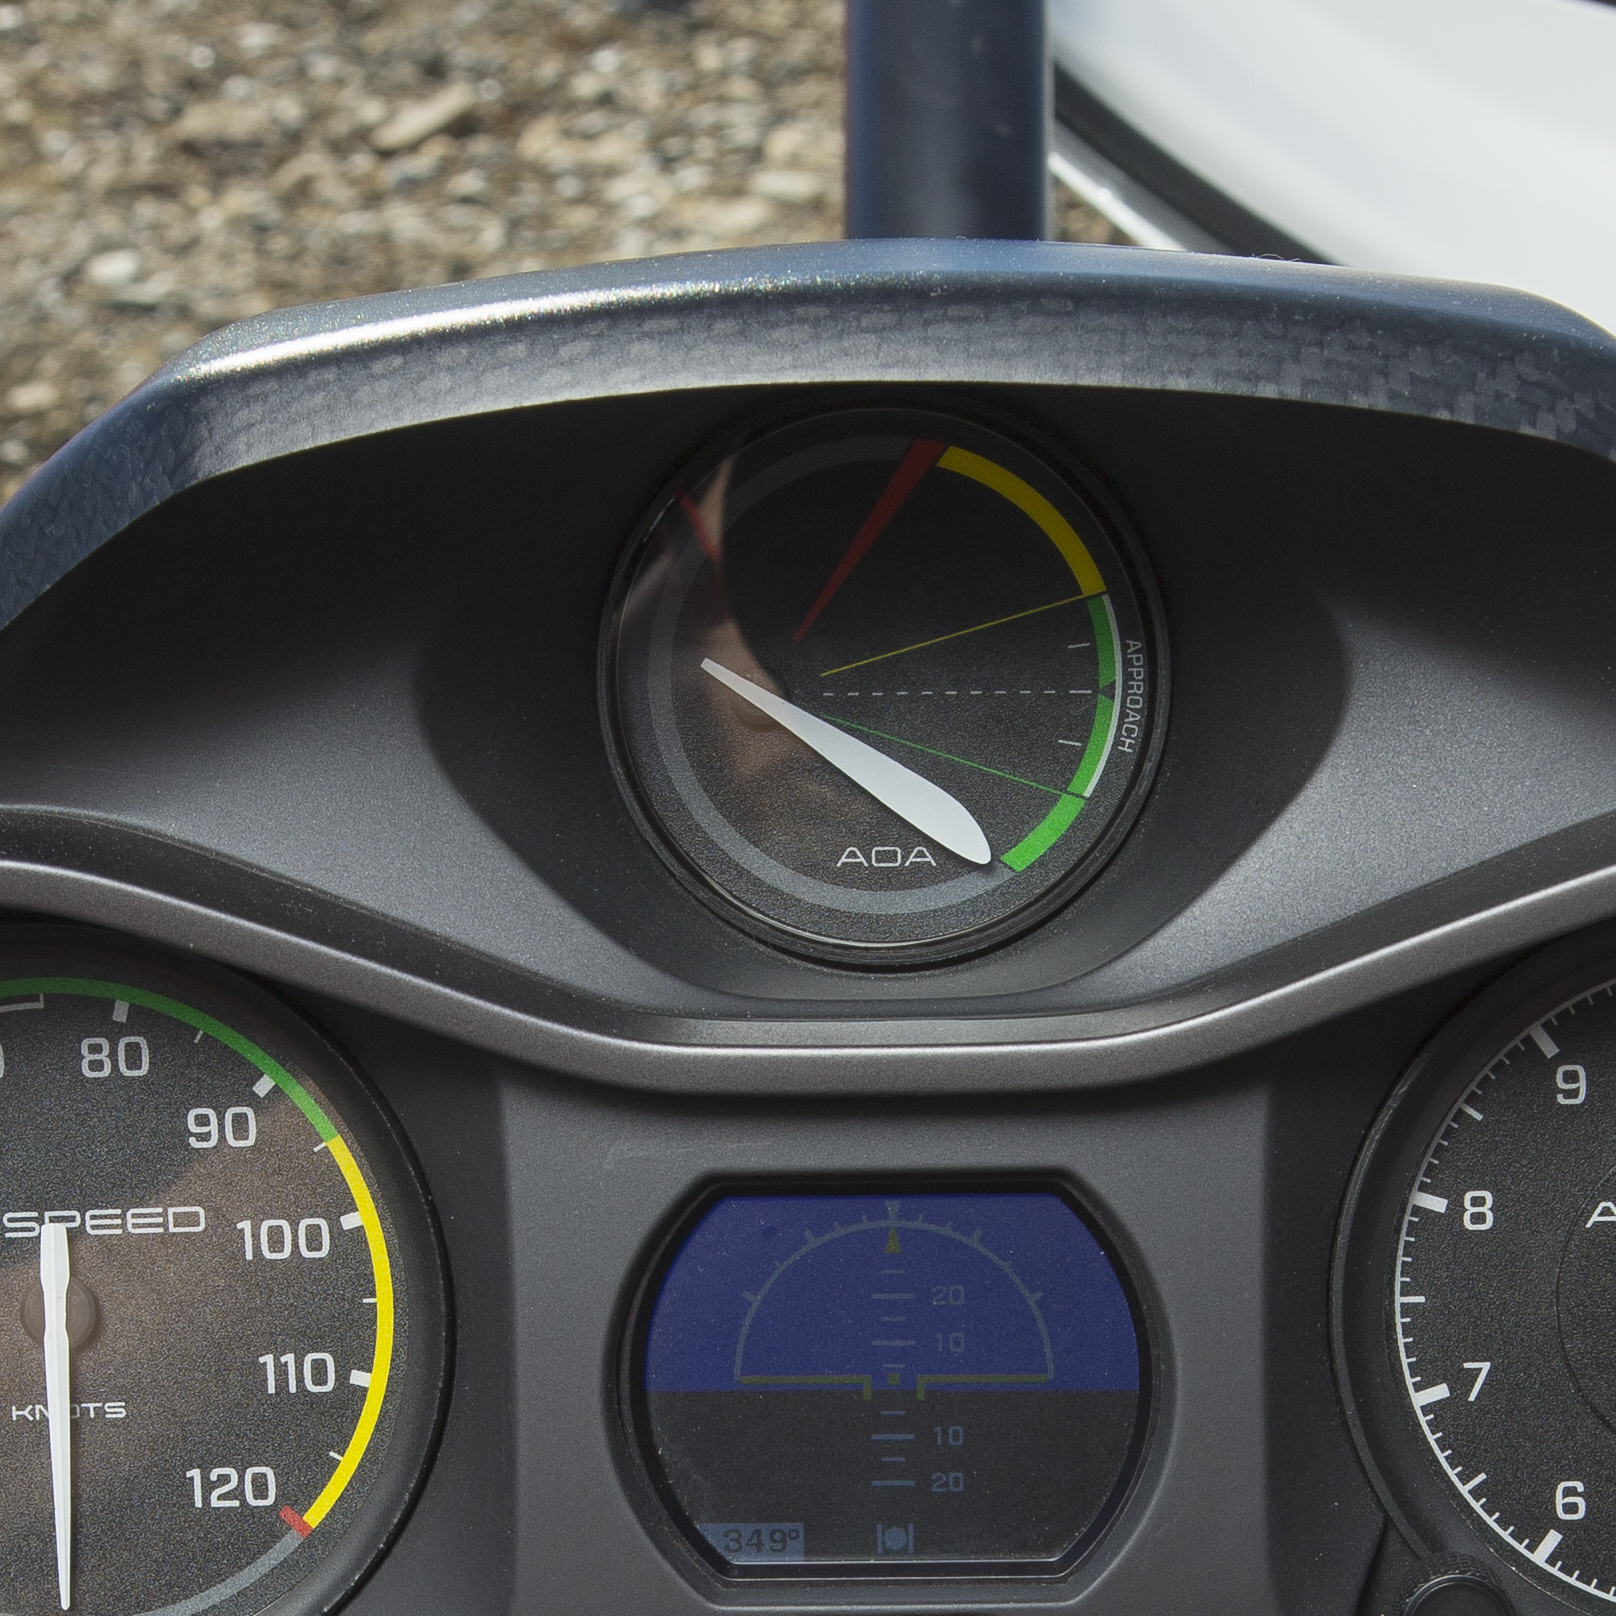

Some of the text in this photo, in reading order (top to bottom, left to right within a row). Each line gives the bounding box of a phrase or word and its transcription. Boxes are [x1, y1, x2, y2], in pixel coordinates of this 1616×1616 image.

[1117, 639, 1145, 753] APPROACH
[836, 846, 937, 867] AOA
[80, 1036, 150, 1078] 80
[1556, 1065, 1587, 1105] 9
[186, 1106, 257, 1149] 90
[1462, 1190, 1494, 1231] 8
[235, 1218, 330, 1260] 100
[931, 1284, 965, 1306] 20
[935, 1331, 966, 1352] 10
[257, 1353, 336, 1394] 110
[1461, 1361, 1491, 1402] 7
[933, 1425, 965, 1446] 10
[185, 1466, 277, 1508] 120
[931, 1471, 965, 1492] 20
[1555, 1480, 1587, 1521] 6
